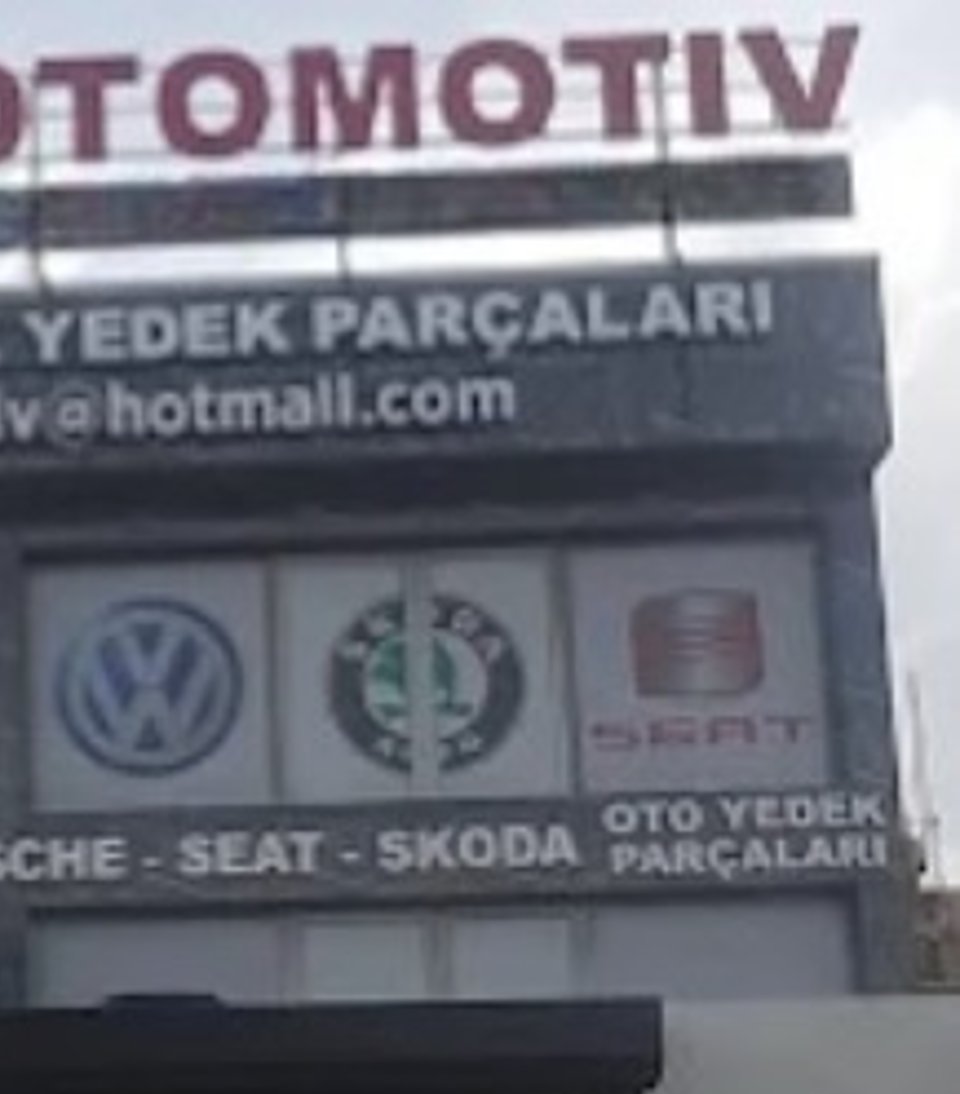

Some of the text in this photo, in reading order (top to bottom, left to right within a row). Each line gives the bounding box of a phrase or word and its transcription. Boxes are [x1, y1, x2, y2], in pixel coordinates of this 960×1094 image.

[24, 300, 292, 363] YEDEK
[313, 281, 773, 357] PARÇALARI
[591, 716, 809, 752] SEAT
[602, 792, 887, 833] OTO YEDEK
[177, 829, 327, 875] SEAT
[377, 823, 581, 870] SKODA
[610, 835, 887, 880] PARÇALARI
